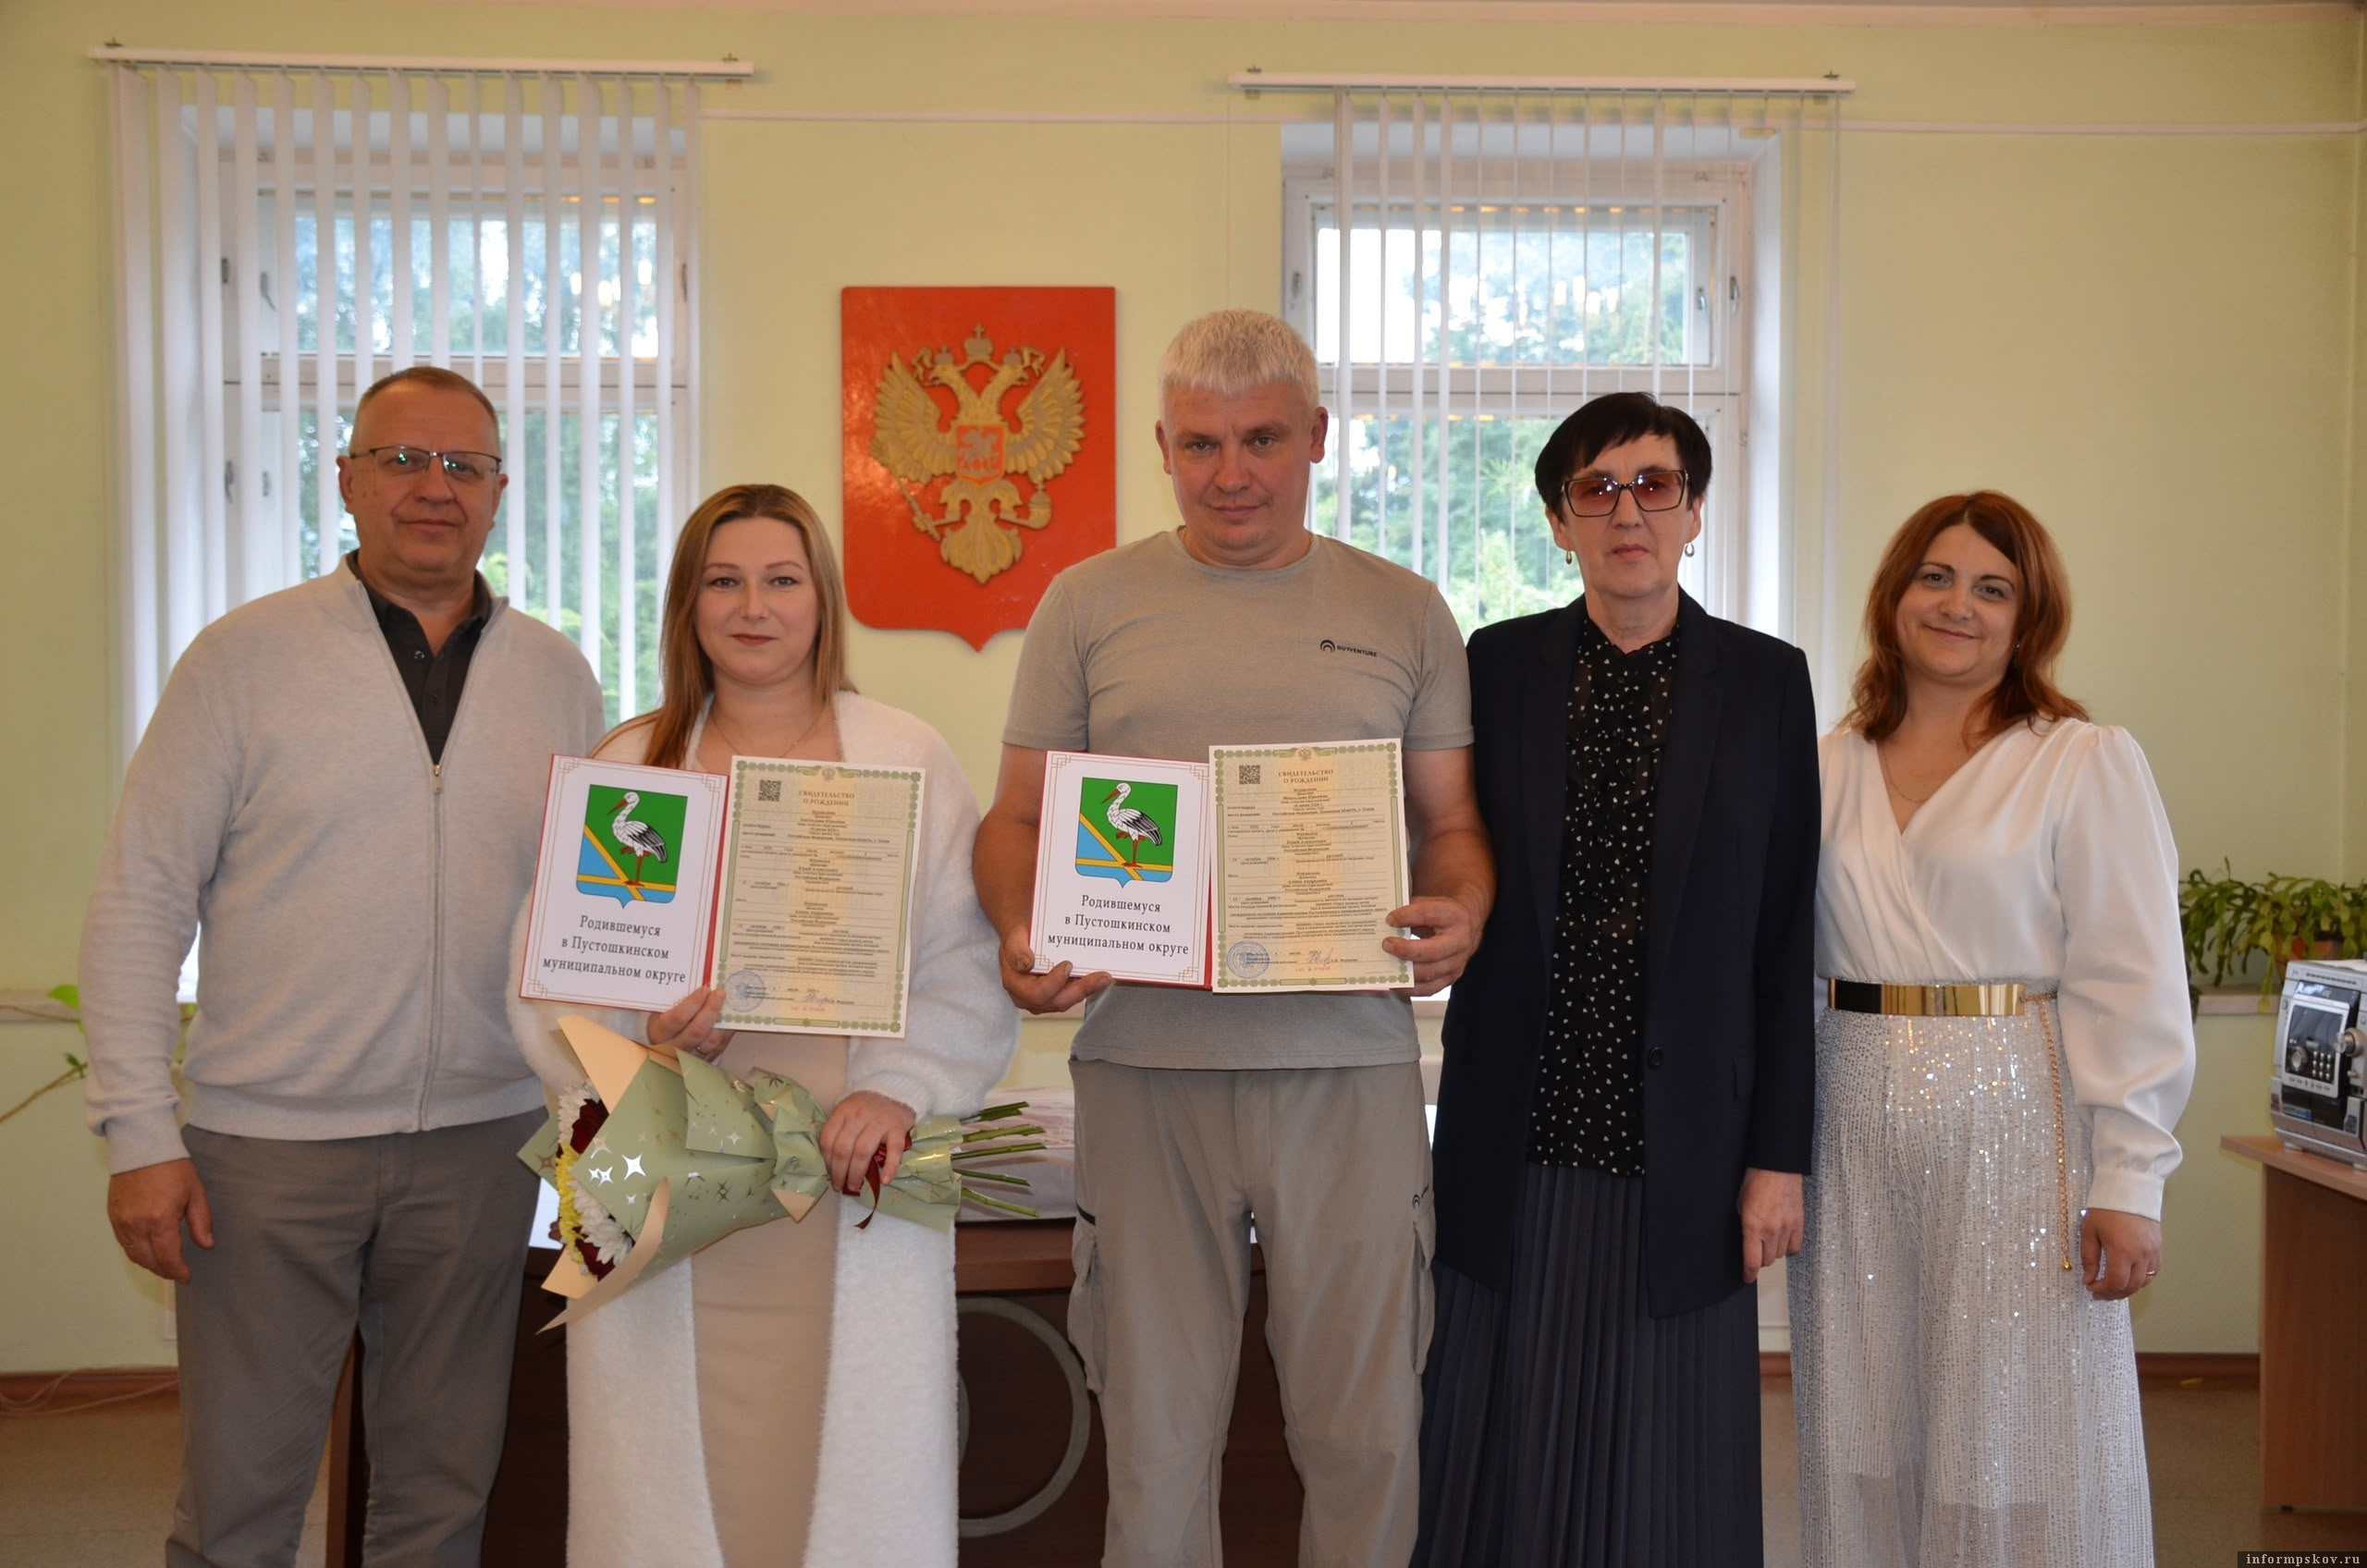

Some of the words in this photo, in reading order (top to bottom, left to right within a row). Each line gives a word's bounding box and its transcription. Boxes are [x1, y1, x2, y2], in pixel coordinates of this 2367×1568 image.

[1336, 645, 1378, 657] OUTVENTURE
[1278, 769, 1333, 778] СВИДЕТЕЛЬСТВО
[1081, 894, 1160, 915] Родившемуся
[580, 914, 661, 938] Родившемуся
[1064, 915, 1071, 925] в
[1074, 913, 1171, 933] Пустошкинском
[561, 937, 568, 948] в
[571, 936, 669, 959] Пустошкинском
[1048, 934, 1145, 950] муниципальном
[1148, 942, 1189, 958] округе
[542, 958, 642, 978] муниципальном
[644, 969, 686, 986] округе
